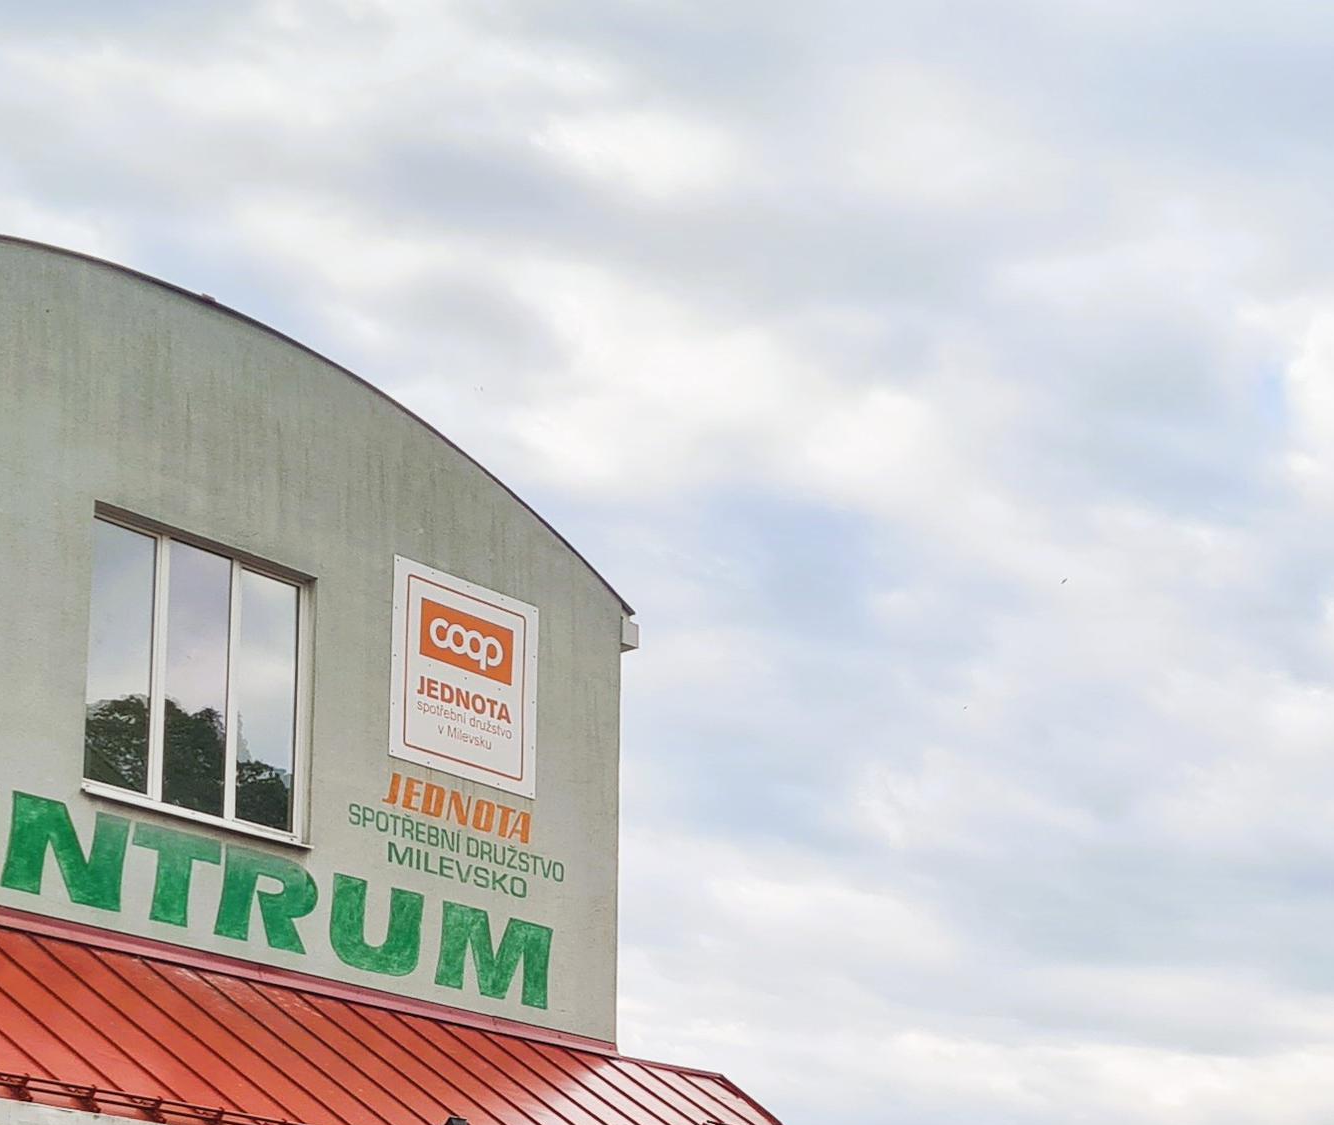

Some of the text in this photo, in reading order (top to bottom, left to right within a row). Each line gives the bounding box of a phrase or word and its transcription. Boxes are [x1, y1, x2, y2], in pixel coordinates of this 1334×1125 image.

[429, 617, 503, 671] coop
[417, 676, 512, 724] JEDNOTA
[417, 701, 513, 740] spotřební družstvo
[437, 725, 492, 750] v Milevsku
[382, 772, 532, 844] JEDNOTA
[348, 804, 565, 882] SPOTŘEBNÍ DRUŽSTVO
[387, 841, 528, 898] MILEVSKO
